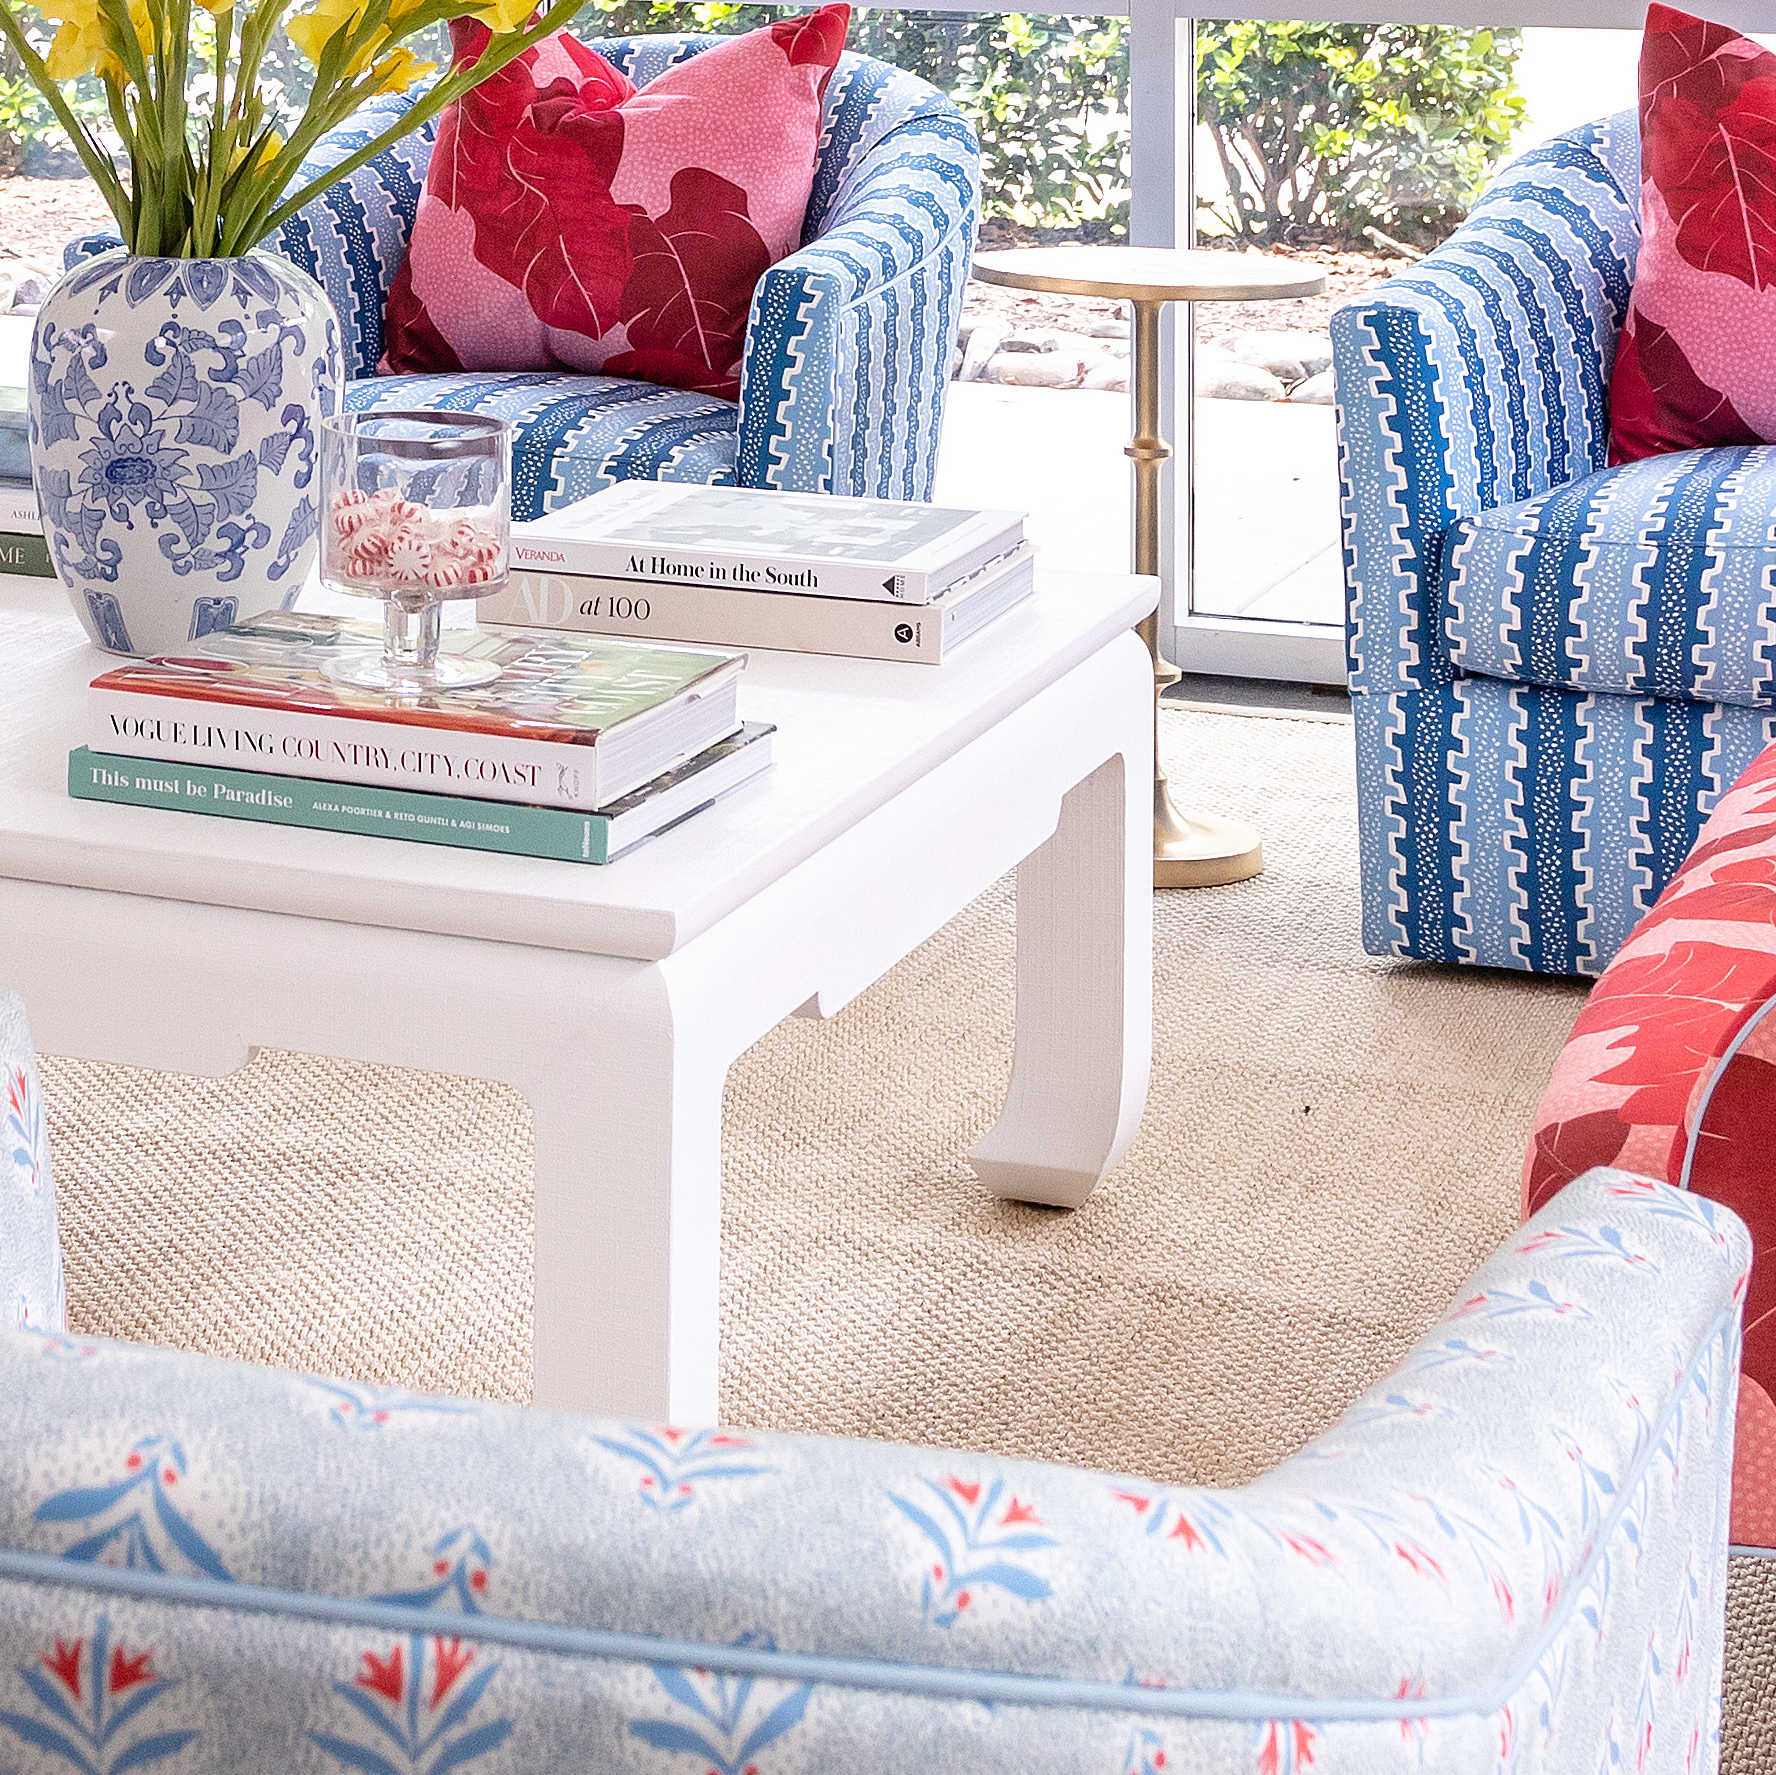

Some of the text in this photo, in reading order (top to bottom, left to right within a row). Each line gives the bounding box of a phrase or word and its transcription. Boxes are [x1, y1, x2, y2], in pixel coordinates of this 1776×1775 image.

[515, 546, 566, 563] VERANDA
[625, 555, 818, 588] At Home in the South
[506, 576, 651, 625] AD at 100
[110, 714, 187, 745] VOGUE
[192, 724, 274, 755] LIVING
[464, 758, 543, 787] COAST
[89, 766, 293, 809] This must be Paradise
[312, 801, 339, 812] ALEXA
[385, 810, 391, 819] &
[451, 819, 457, 828] &
